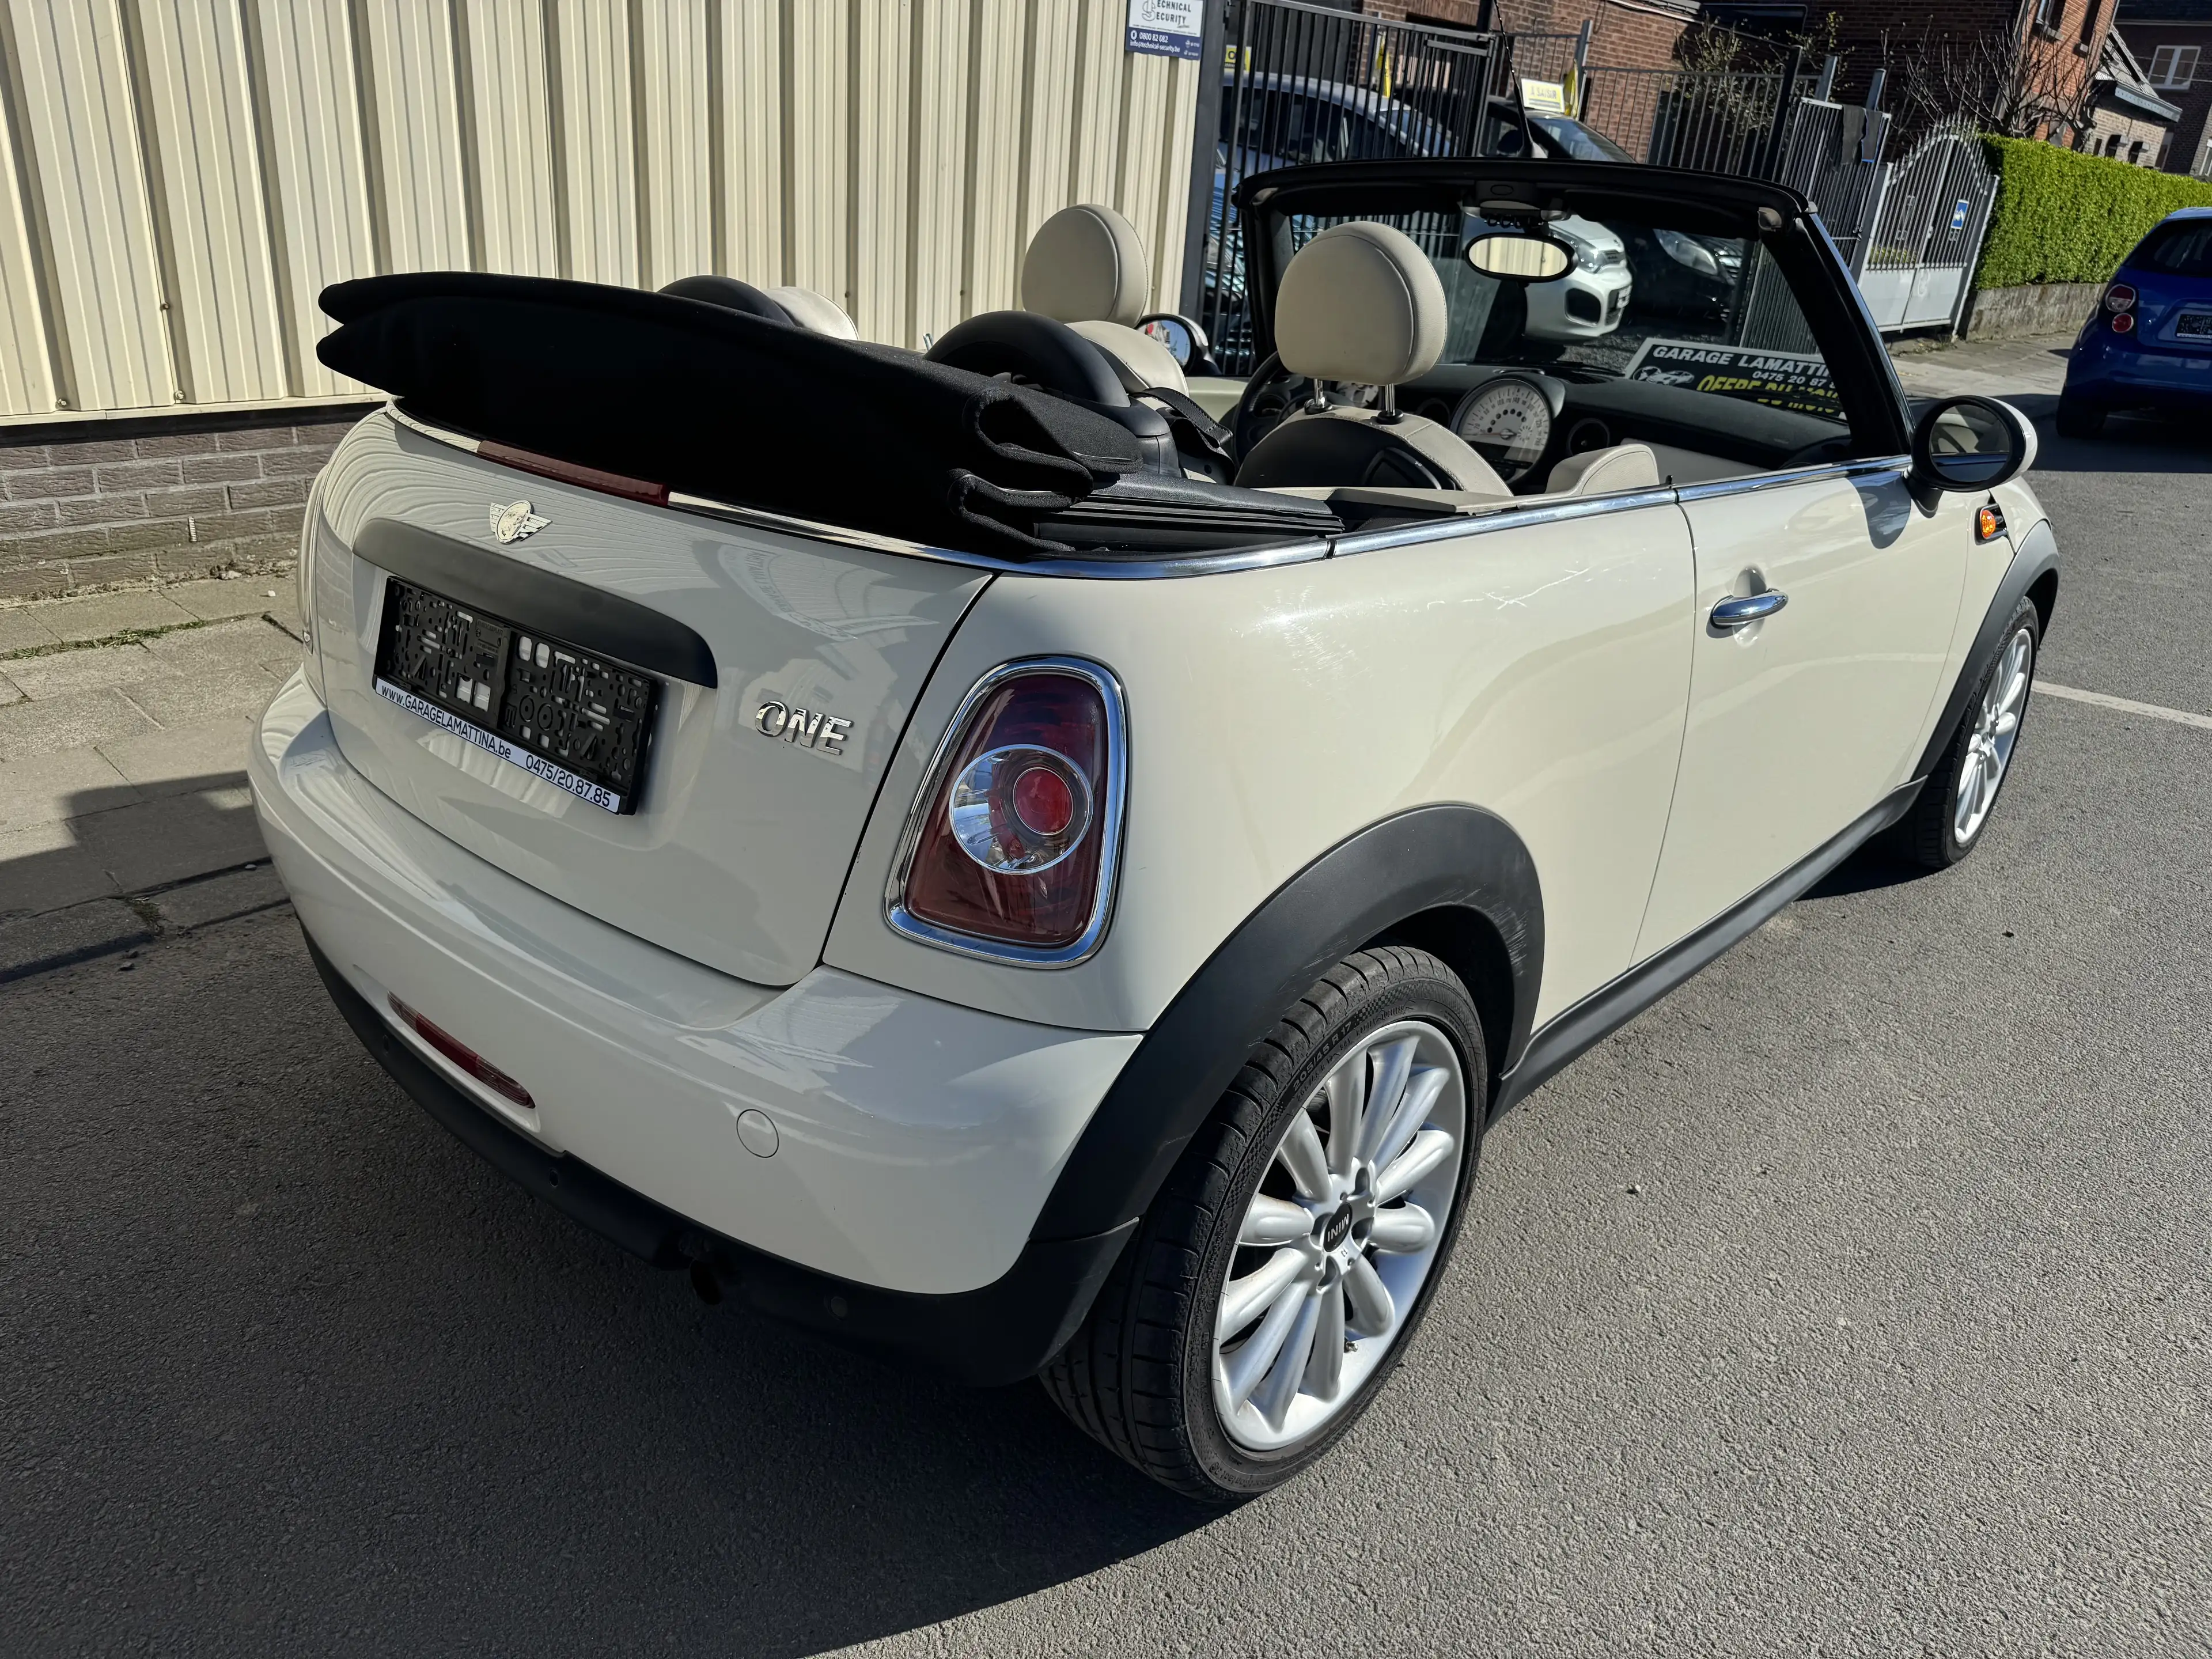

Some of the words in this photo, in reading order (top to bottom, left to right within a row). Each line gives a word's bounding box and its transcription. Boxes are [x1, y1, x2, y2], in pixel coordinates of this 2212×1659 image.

[1653, 346, 1734, 365] GARAGE
[1752, 371, 1785, 382] 0475
[1787, 376, 1805, 384] 20
[1809, 378, 1827, 387] 87
[755, 700, 854, 755] ONE
[381, 685, 512, 759] www.GARAGELAMATTINA.be
[525, 754, 611, 808] 0475/20.87.85
[1341, 1021, 1351, 1035] 17
[1327, 1213, 1349, 1243] MINI
